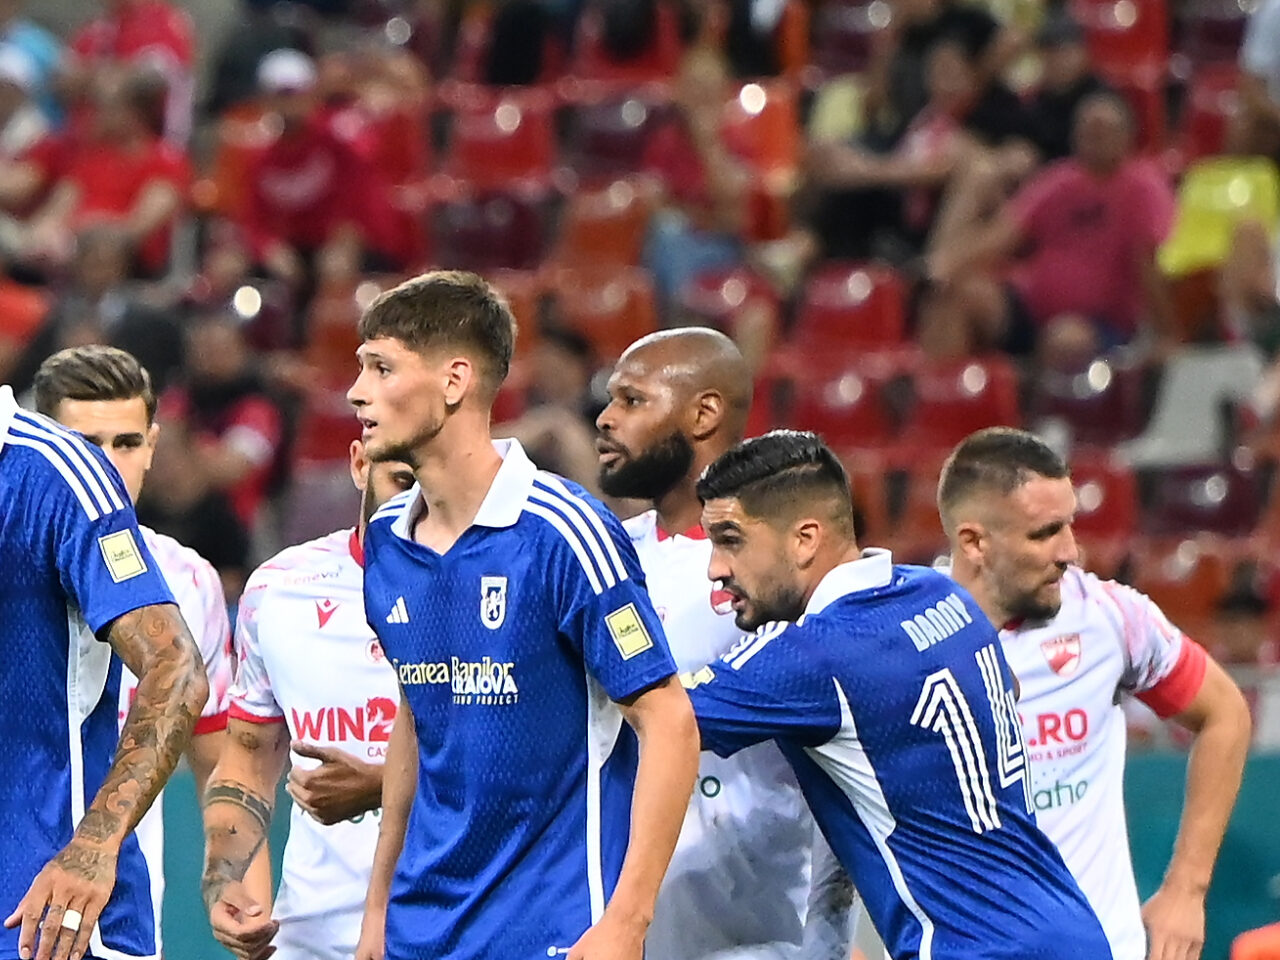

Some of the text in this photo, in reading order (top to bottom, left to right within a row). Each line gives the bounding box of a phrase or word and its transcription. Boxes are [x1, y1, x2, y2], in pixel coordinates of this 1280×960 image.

[900, 592, 973, 652] DANNY
[393, 658, 450, 685] etatea
[909, 643, 1034, 835] 14
